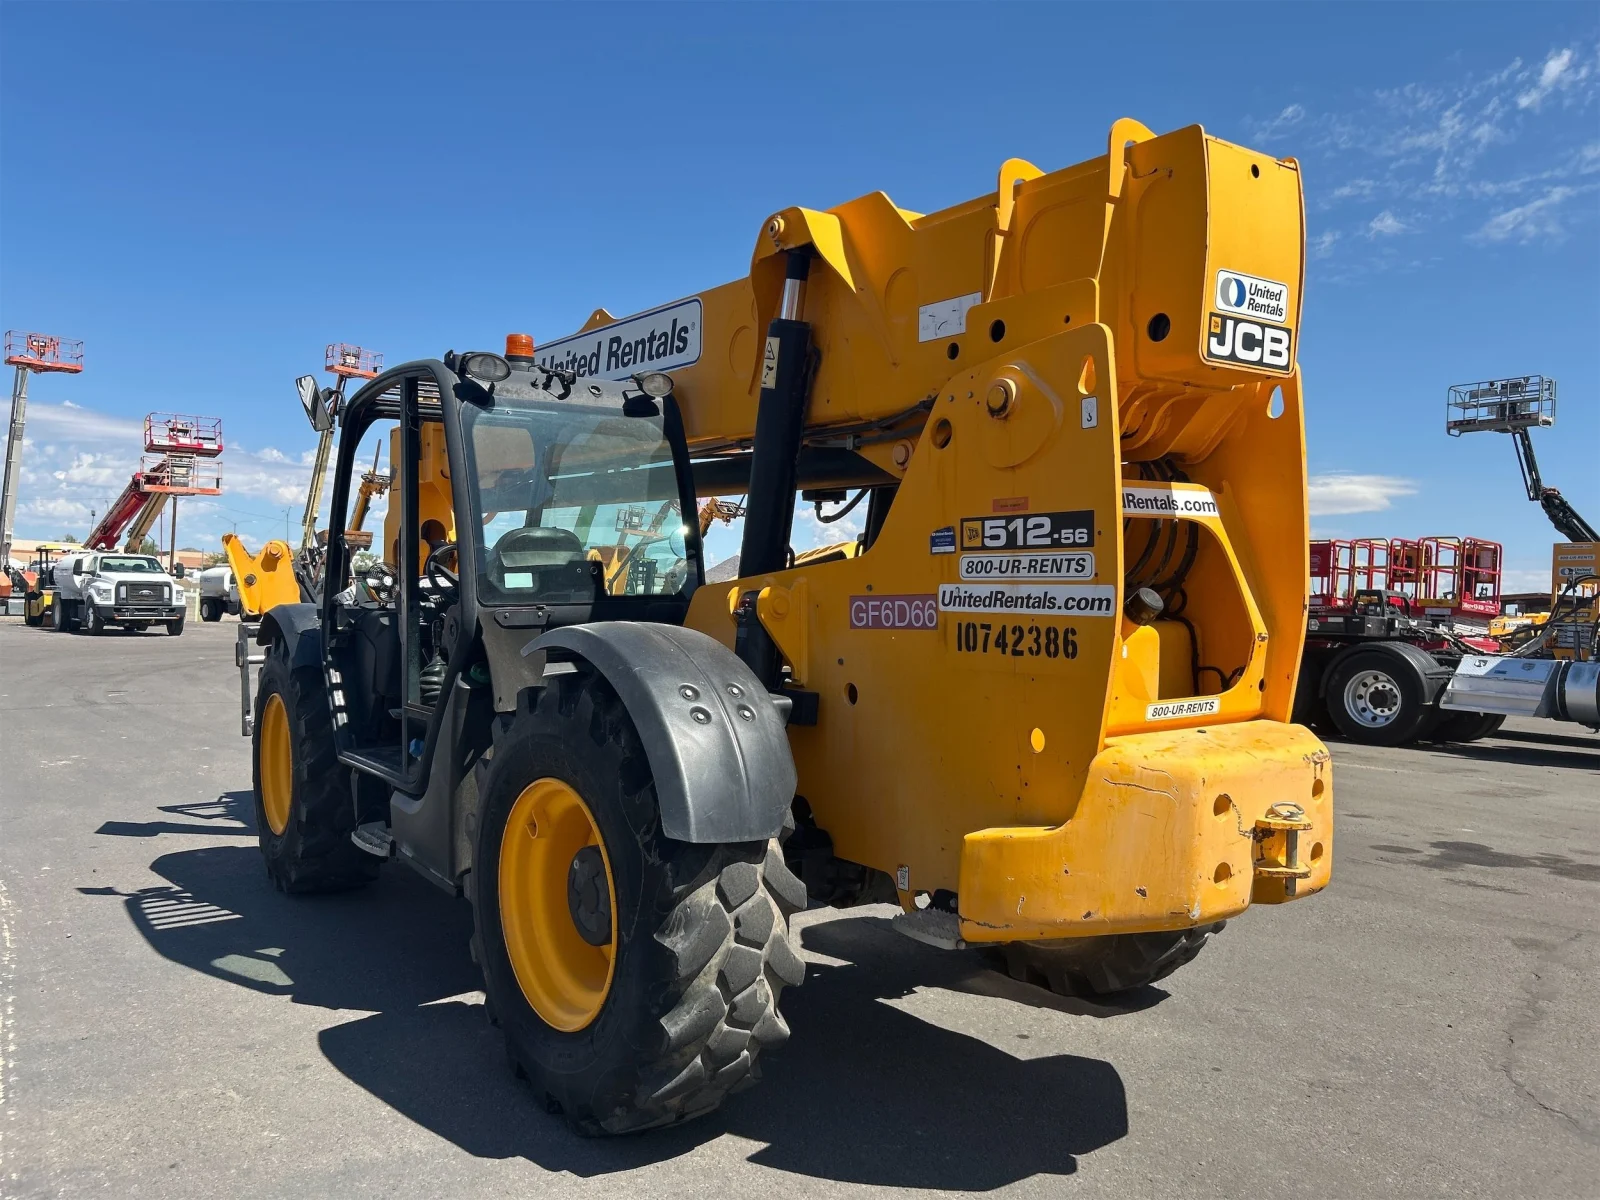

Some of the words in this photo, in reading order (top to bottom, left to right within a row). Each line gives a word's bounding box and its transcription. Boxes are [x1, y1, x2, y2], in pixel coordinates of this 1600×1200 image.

[1249, 283, 1282, 302] United
[1247, 298, 1284, 317] Rentals
[606, 318, 689, 372] Rentals
[1210, 319, 1290, 366] JCB
[983, 516, 1088, 547] 512-56
[965, 557, 1087, 575] 800-UR-RENTS
[941, 590, 1112, 612] UnitedRentals.com
[851, 600, 937, 627] GF6D66
[1151, 701, 1215, 717] 800-UR-RENTS
